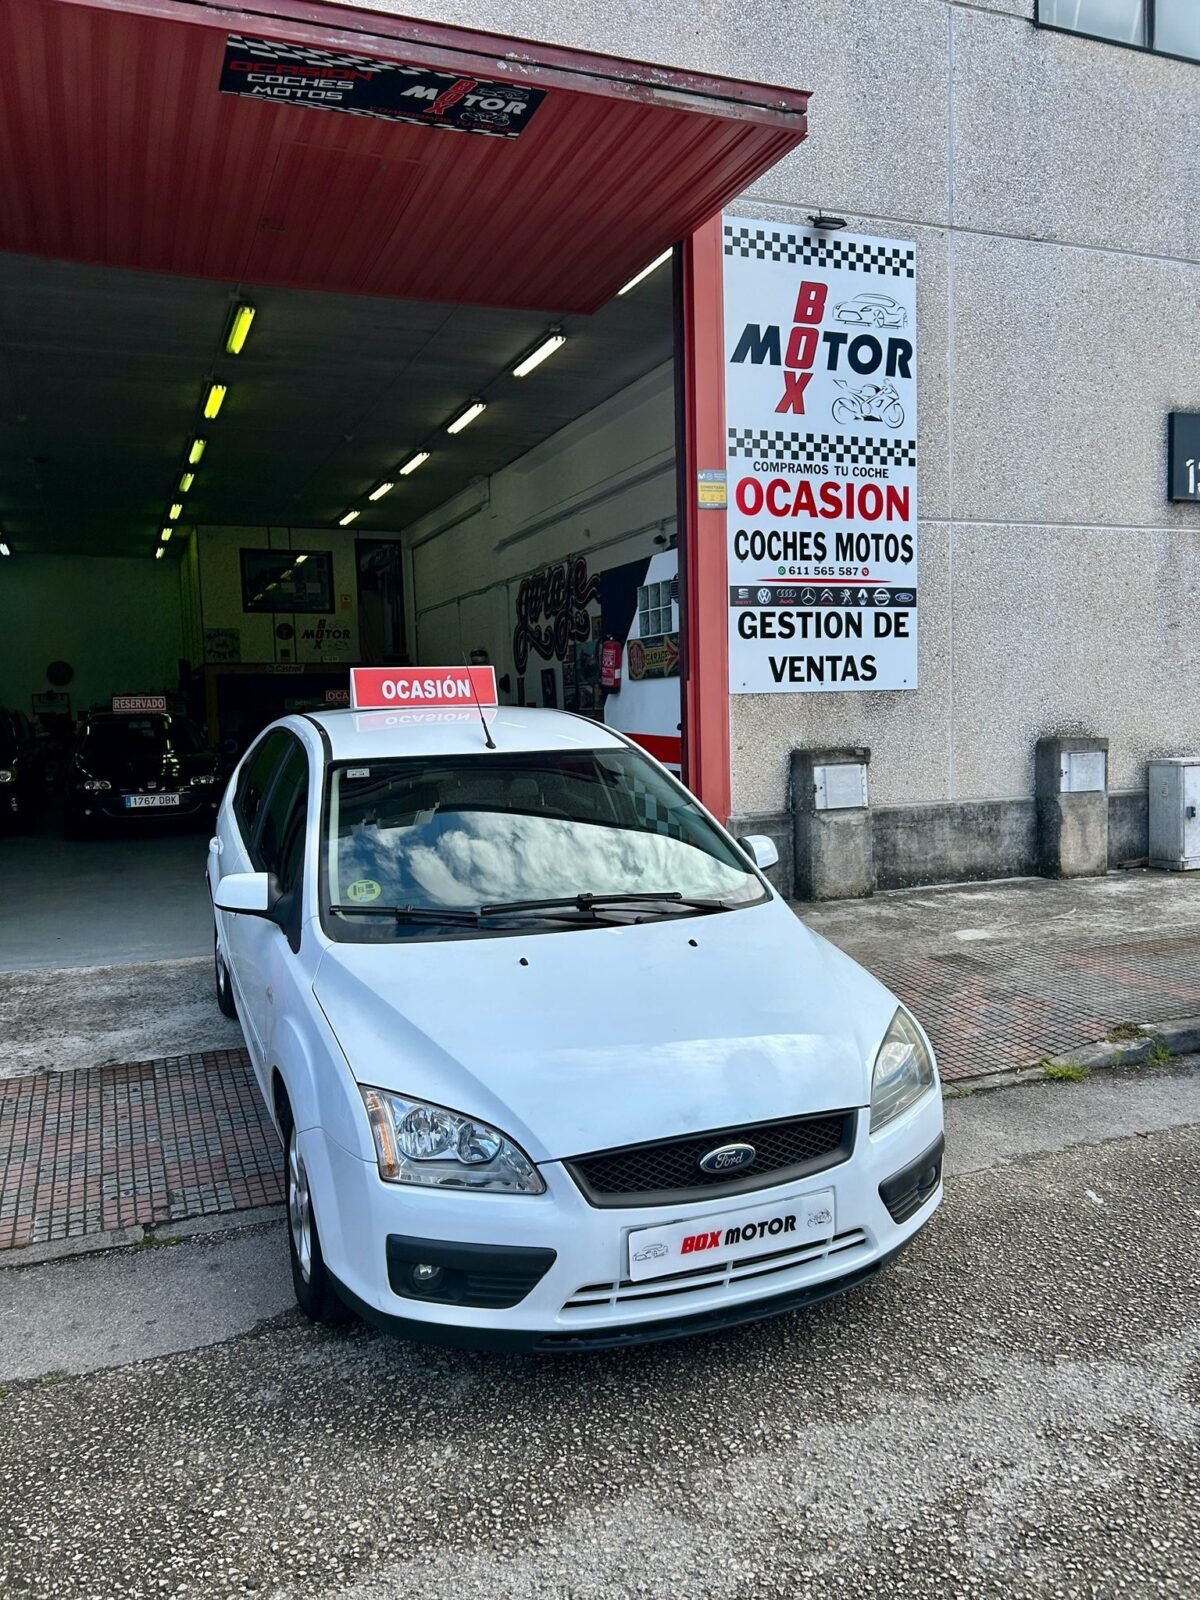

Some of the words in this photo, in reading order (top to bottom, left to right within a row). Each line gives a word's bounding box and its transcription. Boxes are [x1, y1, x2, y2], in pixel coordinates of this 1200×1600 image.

[230, 60, 373, 80] OCASION
[246, 73, 354, 89] COCHES
[251, 85, 343, 100] MOTOS
[400, 84, 528, 115] MOTOR
[425, 79, 478, 115] BOX
[730, 323, 913, 379] MOTOR
[774, 281, 828, 415] BOX
[753, 461, 829, 475] COMPRAMOS
[834, 465, 849, 476] TU
[852, 466, 889, 478] COCHE
[1186, 459, 1200, 494] 1
[735, 476, 910, 522] OCASION
[734, 529, 827, 562] COCHES
[835, 532, 914, 563] MOTOS
[788, 566, 809, 575] 611
[814, 566, 835, 576] 565
[838, 566, 859, 576] 587
[738, 611, 862, 639] GESTION
[874, 611, 909, 639] DE
[768, 655, 877, 683] VENTAS
[328, 690, 349, 700] OCA
[381, 674, 471, 699] OCASIÓN
[114, 698, 164, 709] RESERVADO
[133, 796, 156, 806] 1767
[159, 795, 177, 805] DBK
[714, 1150, 744, 1169] Ford
[680, 1229, 723, 1255] BOX
[724, 1214, 797, 1246] MOTOR
